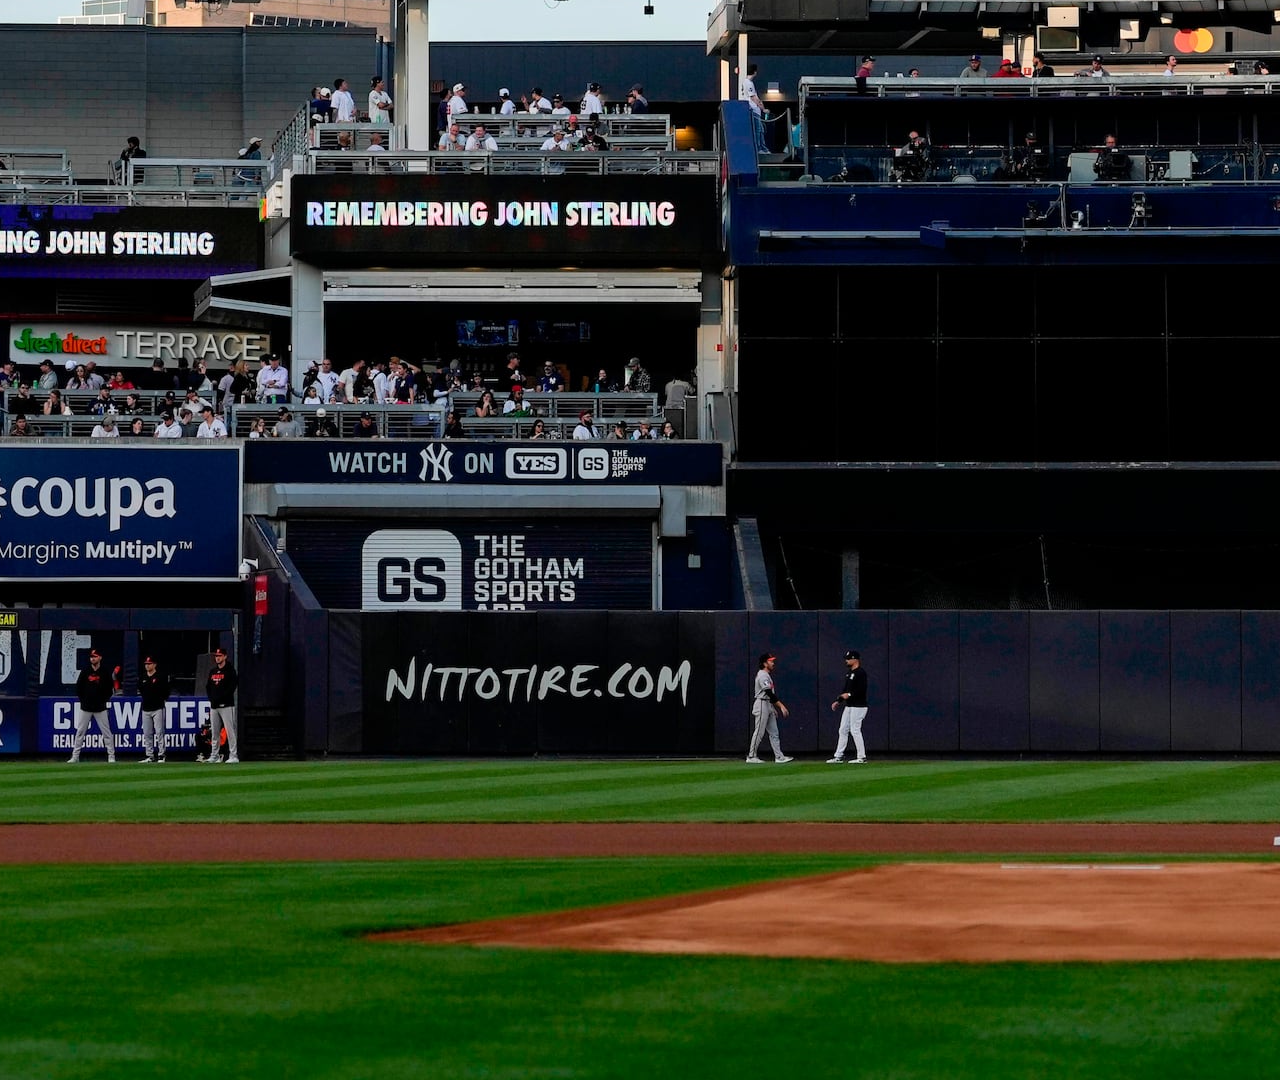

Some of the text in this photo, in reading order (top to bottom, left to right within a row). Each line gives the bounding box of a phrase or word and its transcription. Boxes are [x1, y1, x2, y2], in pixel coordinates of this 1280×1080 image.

[306, 201, 676, 227] REMEMBERING JOHN STERLING
[45, 230, 106, 255] JOHN
[112, 231, 215, 256] STERLING
[14, 328, 261, 361] freshdirect TERRACE
[328, 452, 407, 474] WATCH
[464, 452, 494, 474] ON
[516, 456, 557, 472] YES
[583, 457, 604, 471] GS
[611, 449, 628, 457] THE
[611, 470, 629, 478] APP
[11, 476, 176, 531] coupa
[473, 535, 526, 557] THE
[377, 557, 584, 603] GS GOTHAM
[473, 580, 576, 602] SPORTS
[386, 656, 691, 708] NITTOTIRE.COM
